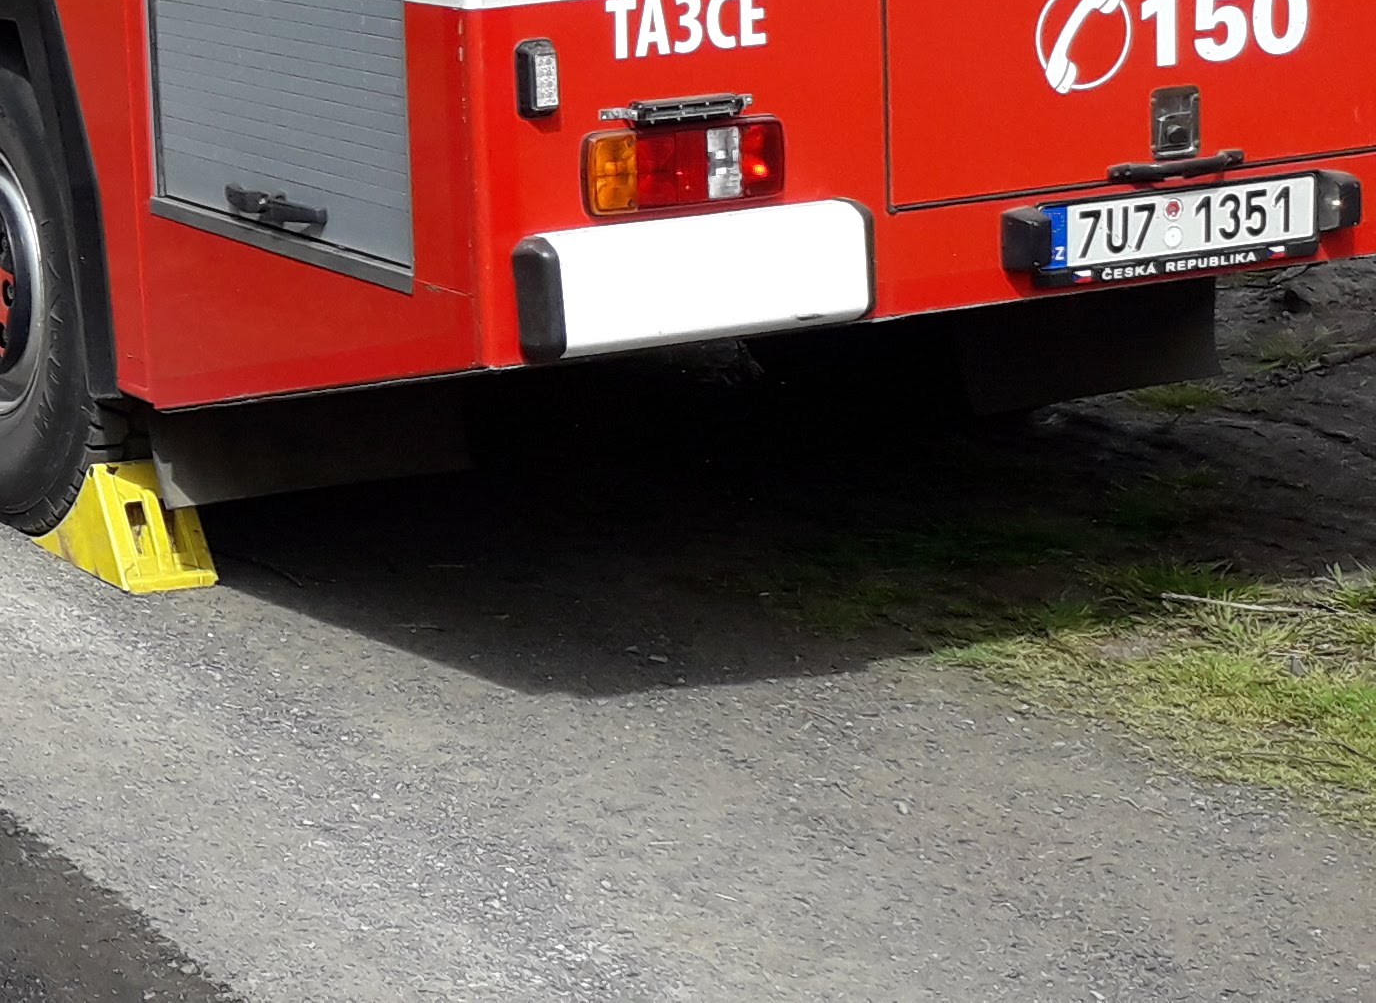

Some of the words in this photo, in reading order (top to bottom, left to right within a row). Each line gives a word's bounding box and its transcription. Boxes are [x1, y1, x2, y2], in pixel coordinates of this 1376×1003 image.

[1079, 203, 1156, 259] 7U7
[1195, 185, 1291, 244] 1351
[1101, 261, 1158, 281] ČESKÁ
[1165, 251, 1257, 273] REPUBLIKA
